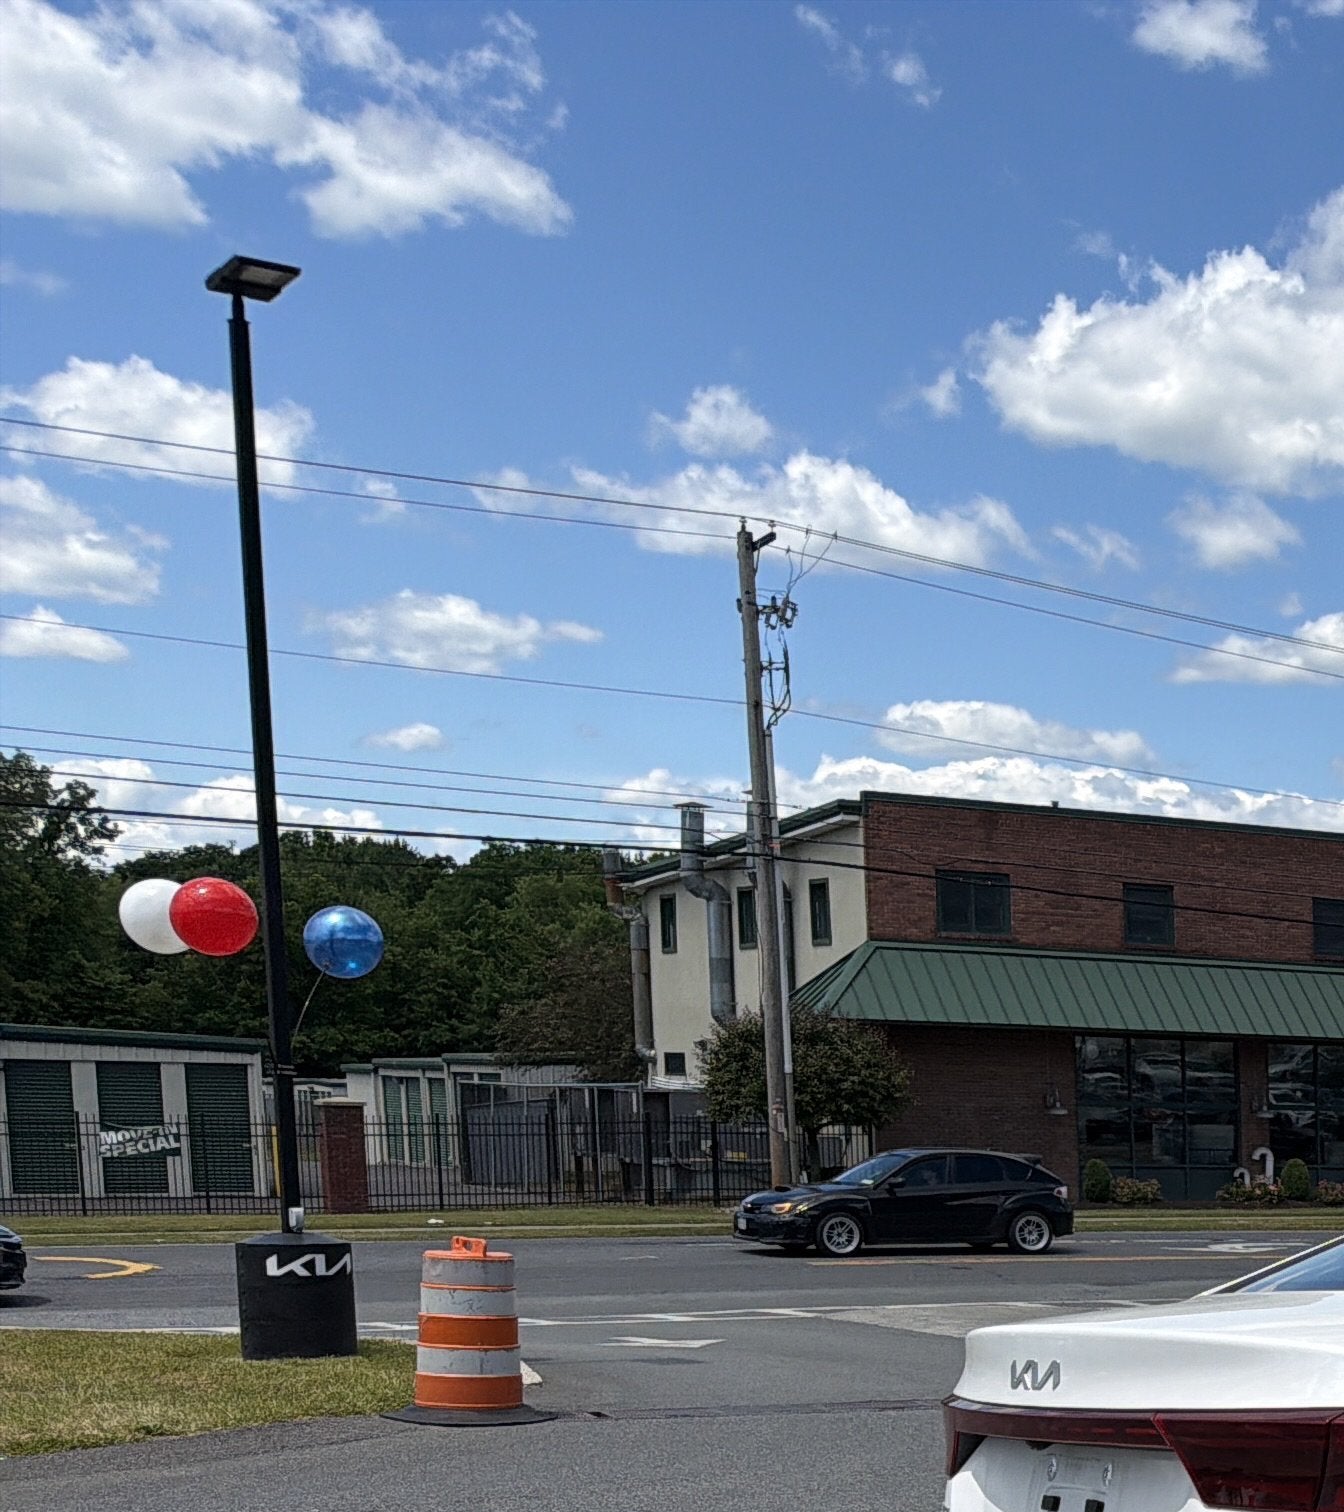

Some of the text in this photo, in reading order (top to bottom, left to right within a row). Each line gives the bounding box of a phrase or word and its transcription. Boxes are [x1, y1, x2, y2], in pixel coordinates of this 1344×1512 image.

[99, 1124, 179, 1144] MOVE-IN
[99, 1134, 181, 1157] SPECIAL
[265, 1252, 351, 1277] KIA
[1010, 1360, 1060, 1392] KIA
